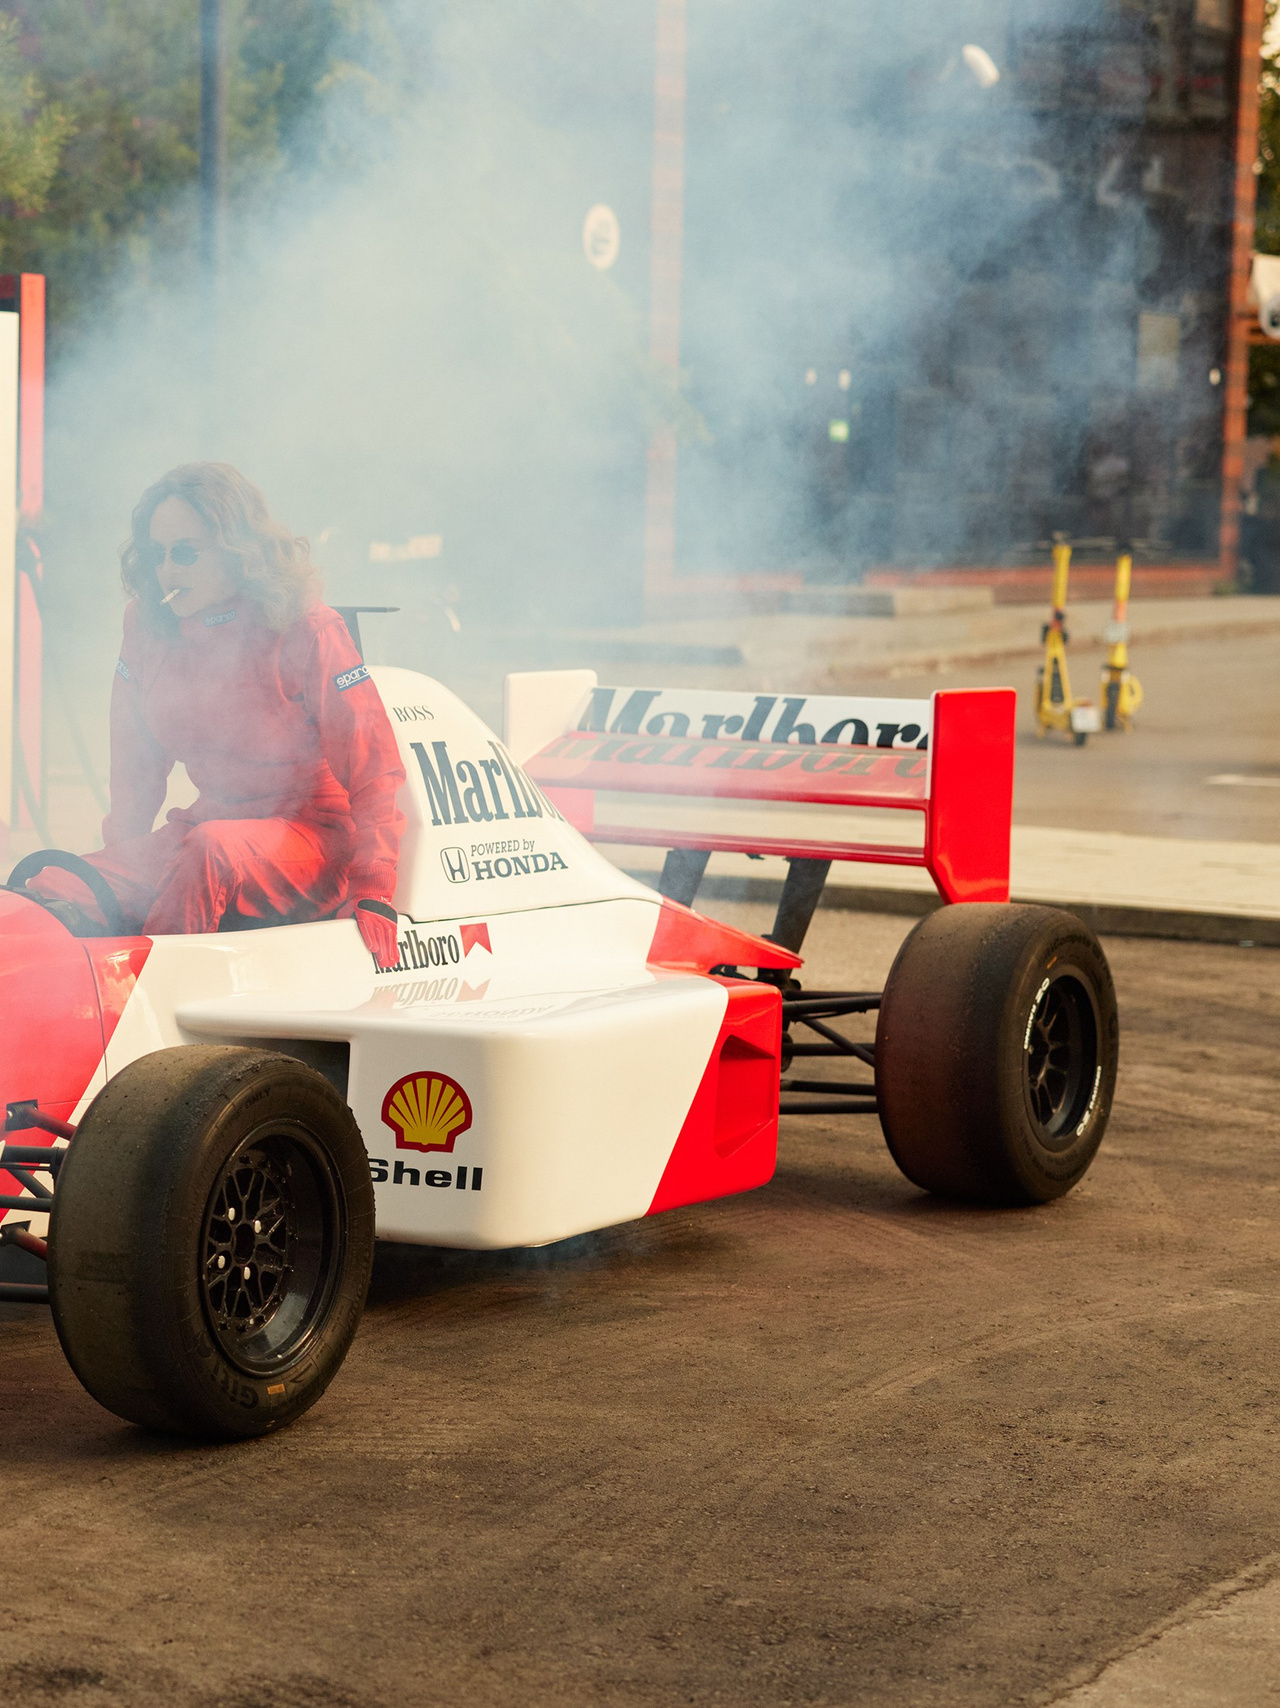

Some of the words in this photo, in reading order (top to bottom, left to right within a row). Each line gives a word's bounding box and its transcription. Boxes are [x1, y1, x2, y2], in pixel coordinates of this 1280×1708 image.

[336, 665, 370, 688] sparc
[392, 705, 435, 723] BOSS
[470, 841, 520, 857] POWERED
[522, 840, 535, 853] by
[471, 851, 568, 881] HONDA
[372, 929, 460, 975] rlboro
[367, 1158, 483, 1191] Shell
